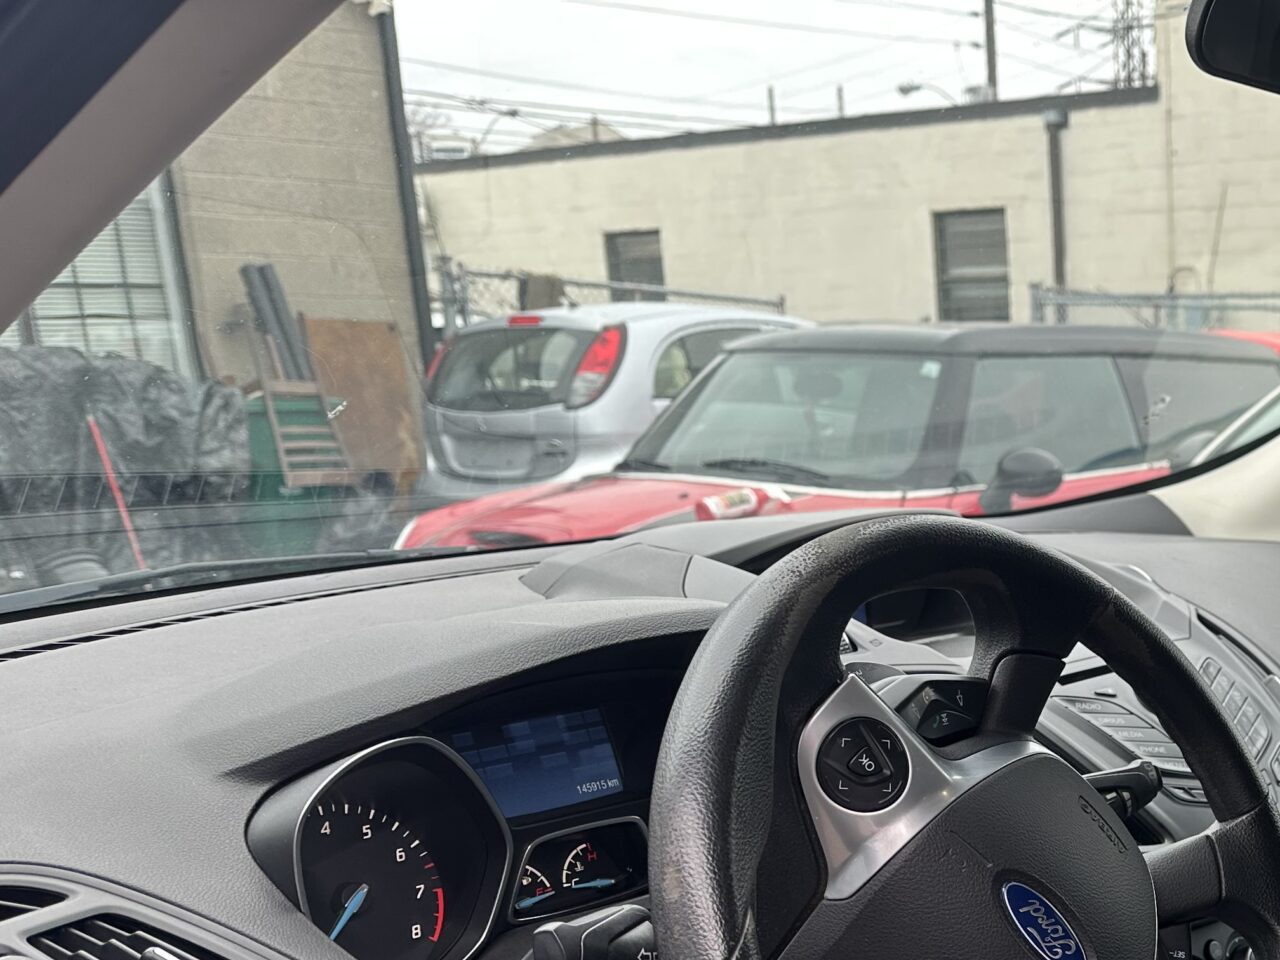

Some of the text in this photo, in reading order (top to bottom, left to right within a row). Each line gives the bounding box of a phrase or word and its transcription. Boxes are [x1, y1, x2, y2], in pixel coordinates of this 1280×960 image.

[1075, 702, 1102, 710] RADIO
[858, 753, 875, 771] OK
[576, 778, 620, 794] 145915 km
[320, 821, 331, 835] 4
[362, 824, 372, 839] 5
[395, 848, 406, 862] 6
[415, 884, 425, 899] 7
[411, 924, 421, 939] 8
[1018, 899, 1076, 959] Ford
